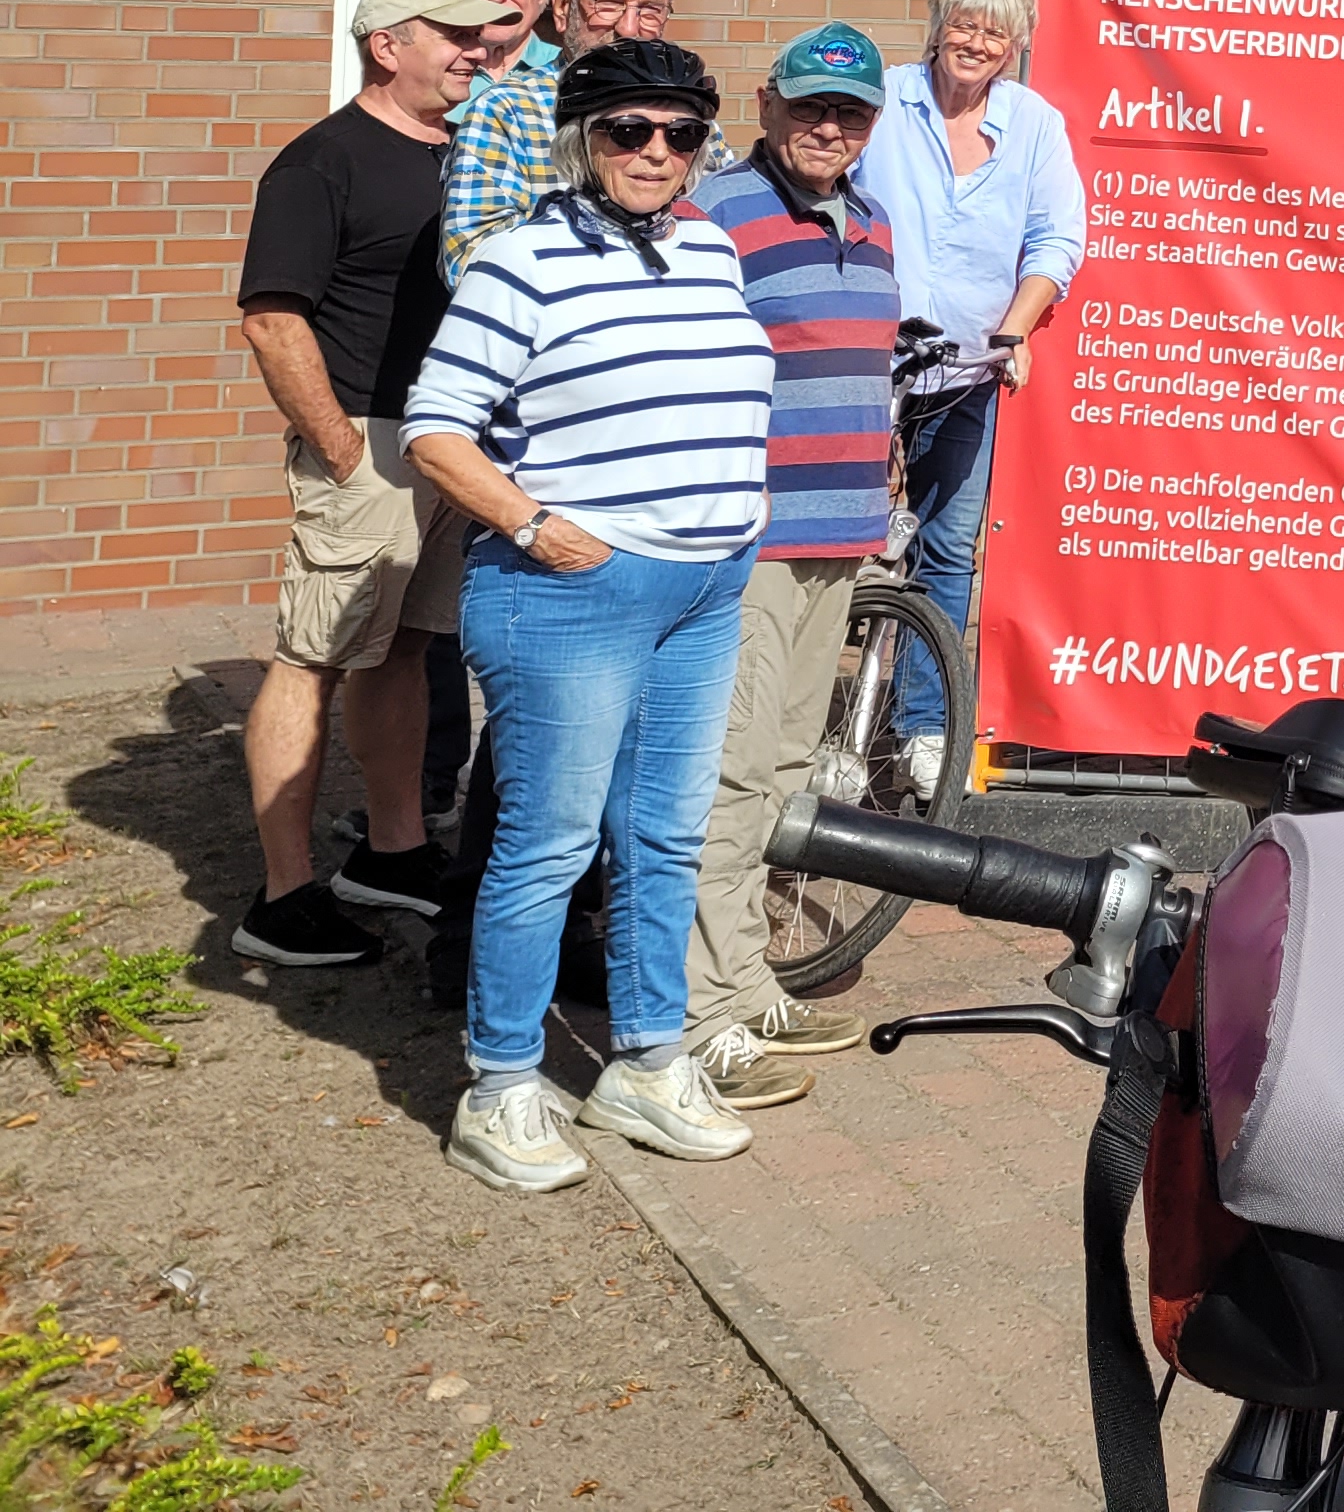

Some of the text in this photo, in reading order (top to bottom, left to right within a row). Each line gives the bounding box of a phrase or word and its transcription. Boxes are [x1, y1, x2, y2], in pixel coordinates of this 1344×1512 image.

[1098, 85, 1223, 134] Artikel
[1093, 169, 1124, 199] (1)
[1130, 173, 1171, 197] Die
[1177, 176, 1257, 203] Würde
[1262, 181, 1303, 207] des
[1091, 203, 1125, 227] Sie
[1130, 211, 1158, 229] zu
[1163, 207, 1247, 235] achten
[1254, 215, 1298, 238] und
[1303, 222, 1330, 240] zu
[1086, 237, 1142, 264] aller
[1145, 241, 1279, 269] staatlichen
[1081, 299, 1112, 329] (2)
[1118, 303, 1164, 328] Das
[1169, 306, 1285, 335] Deutsche
[1290, 314, 1344, 339] Volk
[1077, 332, 1149, 360] lichen
[1155, 338, 1203, 363] und
[1073, 365, 1108, 391] als
[1113, 369, 1240, 402] Grundlage
[1242, 376, 1311, 405] jeder
[1070, 398, 1114, 425] des
[1119, 402, 1224, 431] Friedens
[1230, 409, 1277, 434] und
[1283, 411, 1325, 437] der
[1064, 464, 1097, 495] (3)
[1103, 468, 1144, 493] Die
[1149, 471, 1334, 504] nachfolgenden
[1060, 498, 1160, 532] gebung,
[1166, 502, 1323, 537] vollziehende
[1058, 531, 1092, 557] als
[1098, 536, 1244, 566] unmittelbar
